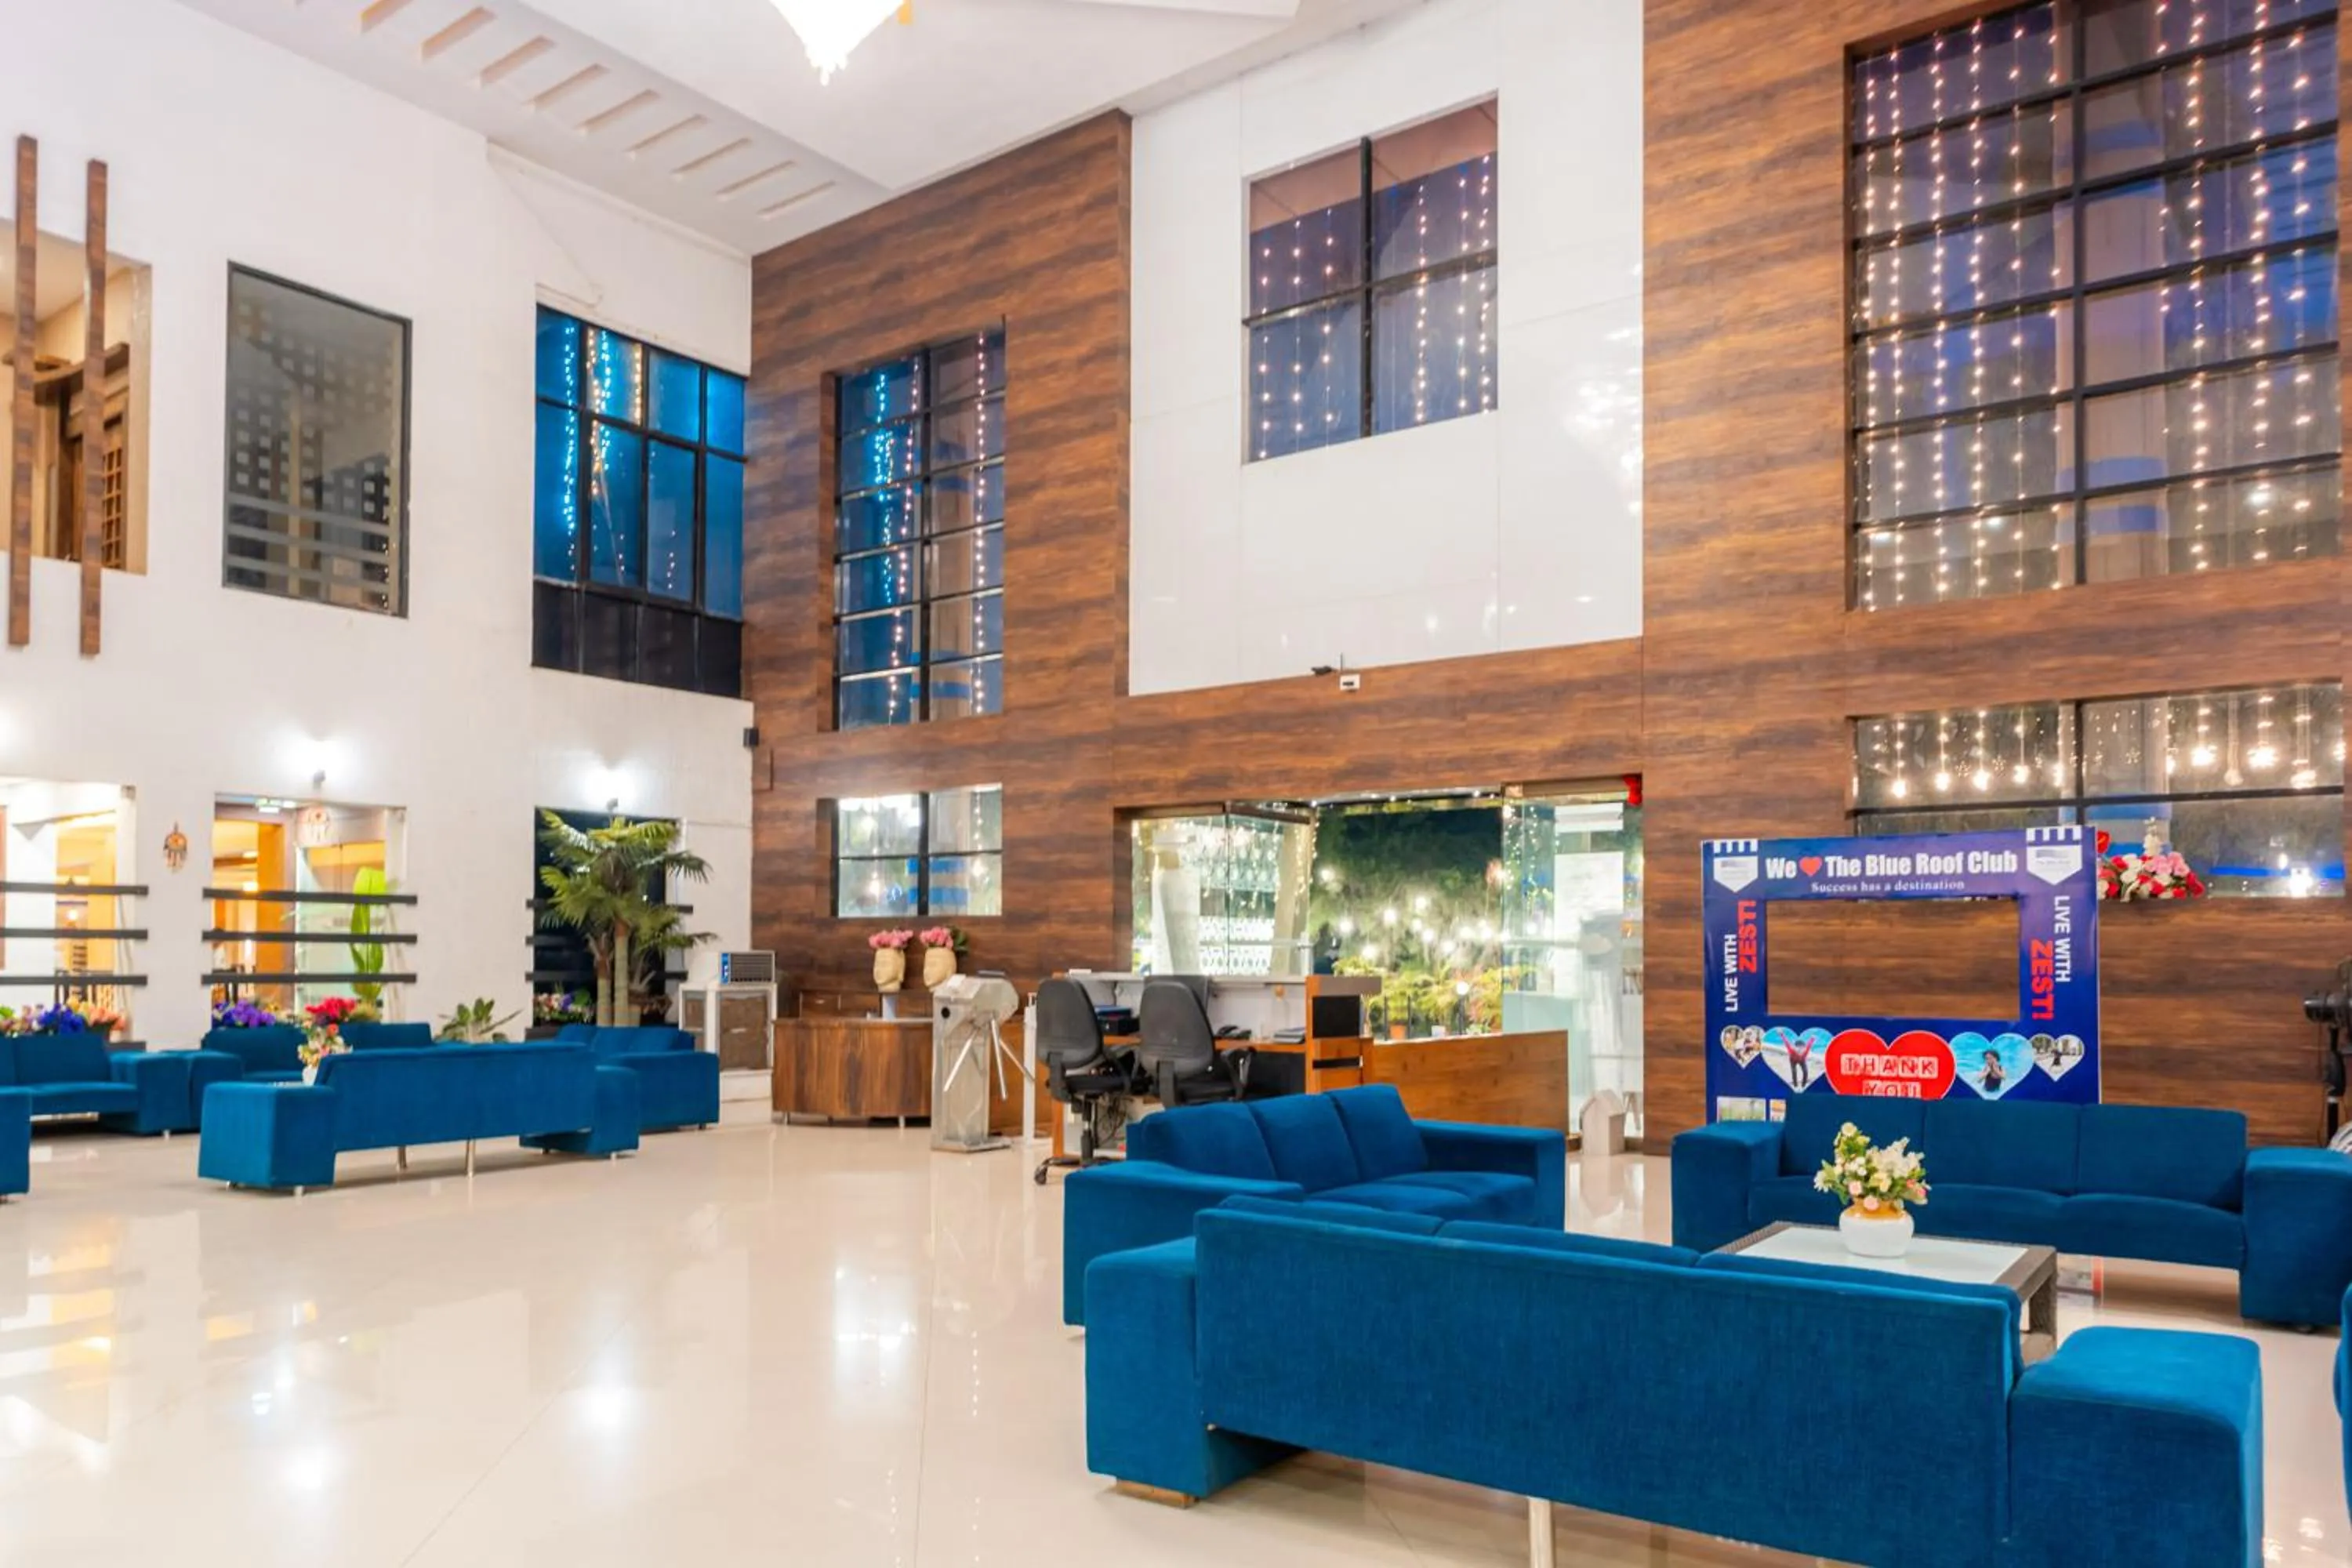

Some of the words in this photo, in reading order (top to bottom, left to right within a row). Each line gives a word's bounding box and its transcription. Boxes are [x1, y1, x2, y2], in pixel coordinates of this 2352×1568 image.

[1766, 857, 1797, 879] We
[1825, 855, 1861, 877] The
[1865, 854, 1911, 876] Blue
[1915, 851, 1964, 875] Roof
[1968, 850, 2018, 873] Club
[1811, 881, 1857, 892] Success
[1860, 880, 1881, 891] has
[1884, 882, 1891, 891] a
[1894, 878, 1965, 891] destination
[2054, 895, 2071, 934] LIVE
[1724, 934, 1737, 974] WITH
[2055, 937, 2071, 982] WITH
[1724, 977, 1738, 1012] LIVE
[1844, 1055, 1935, 1076] THANK
